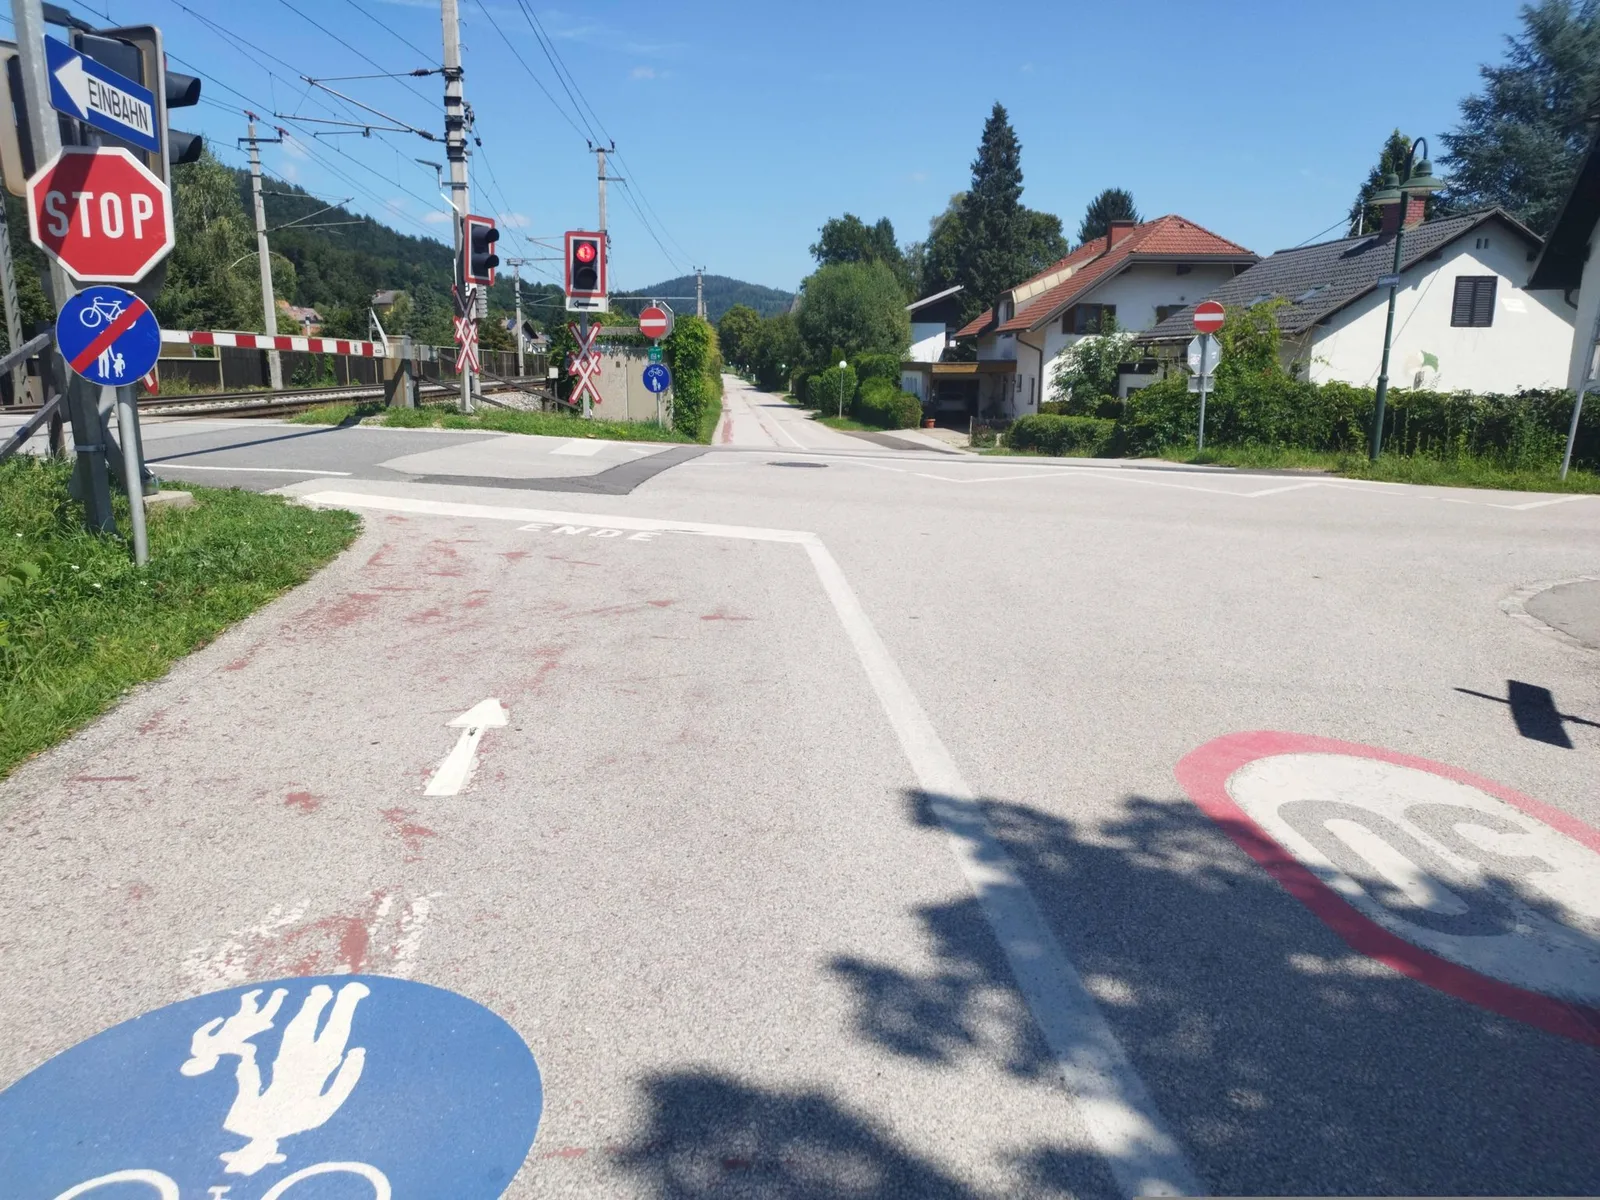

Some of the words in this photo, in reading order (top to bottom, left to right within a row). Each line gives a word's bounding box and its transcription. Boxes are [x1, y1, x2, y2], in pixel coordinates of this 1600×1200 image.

[87, 77, 149, 132] EINBAHN
[46, 191, 154, 239] STOP
[517, 523, 662, 542] ENDE
